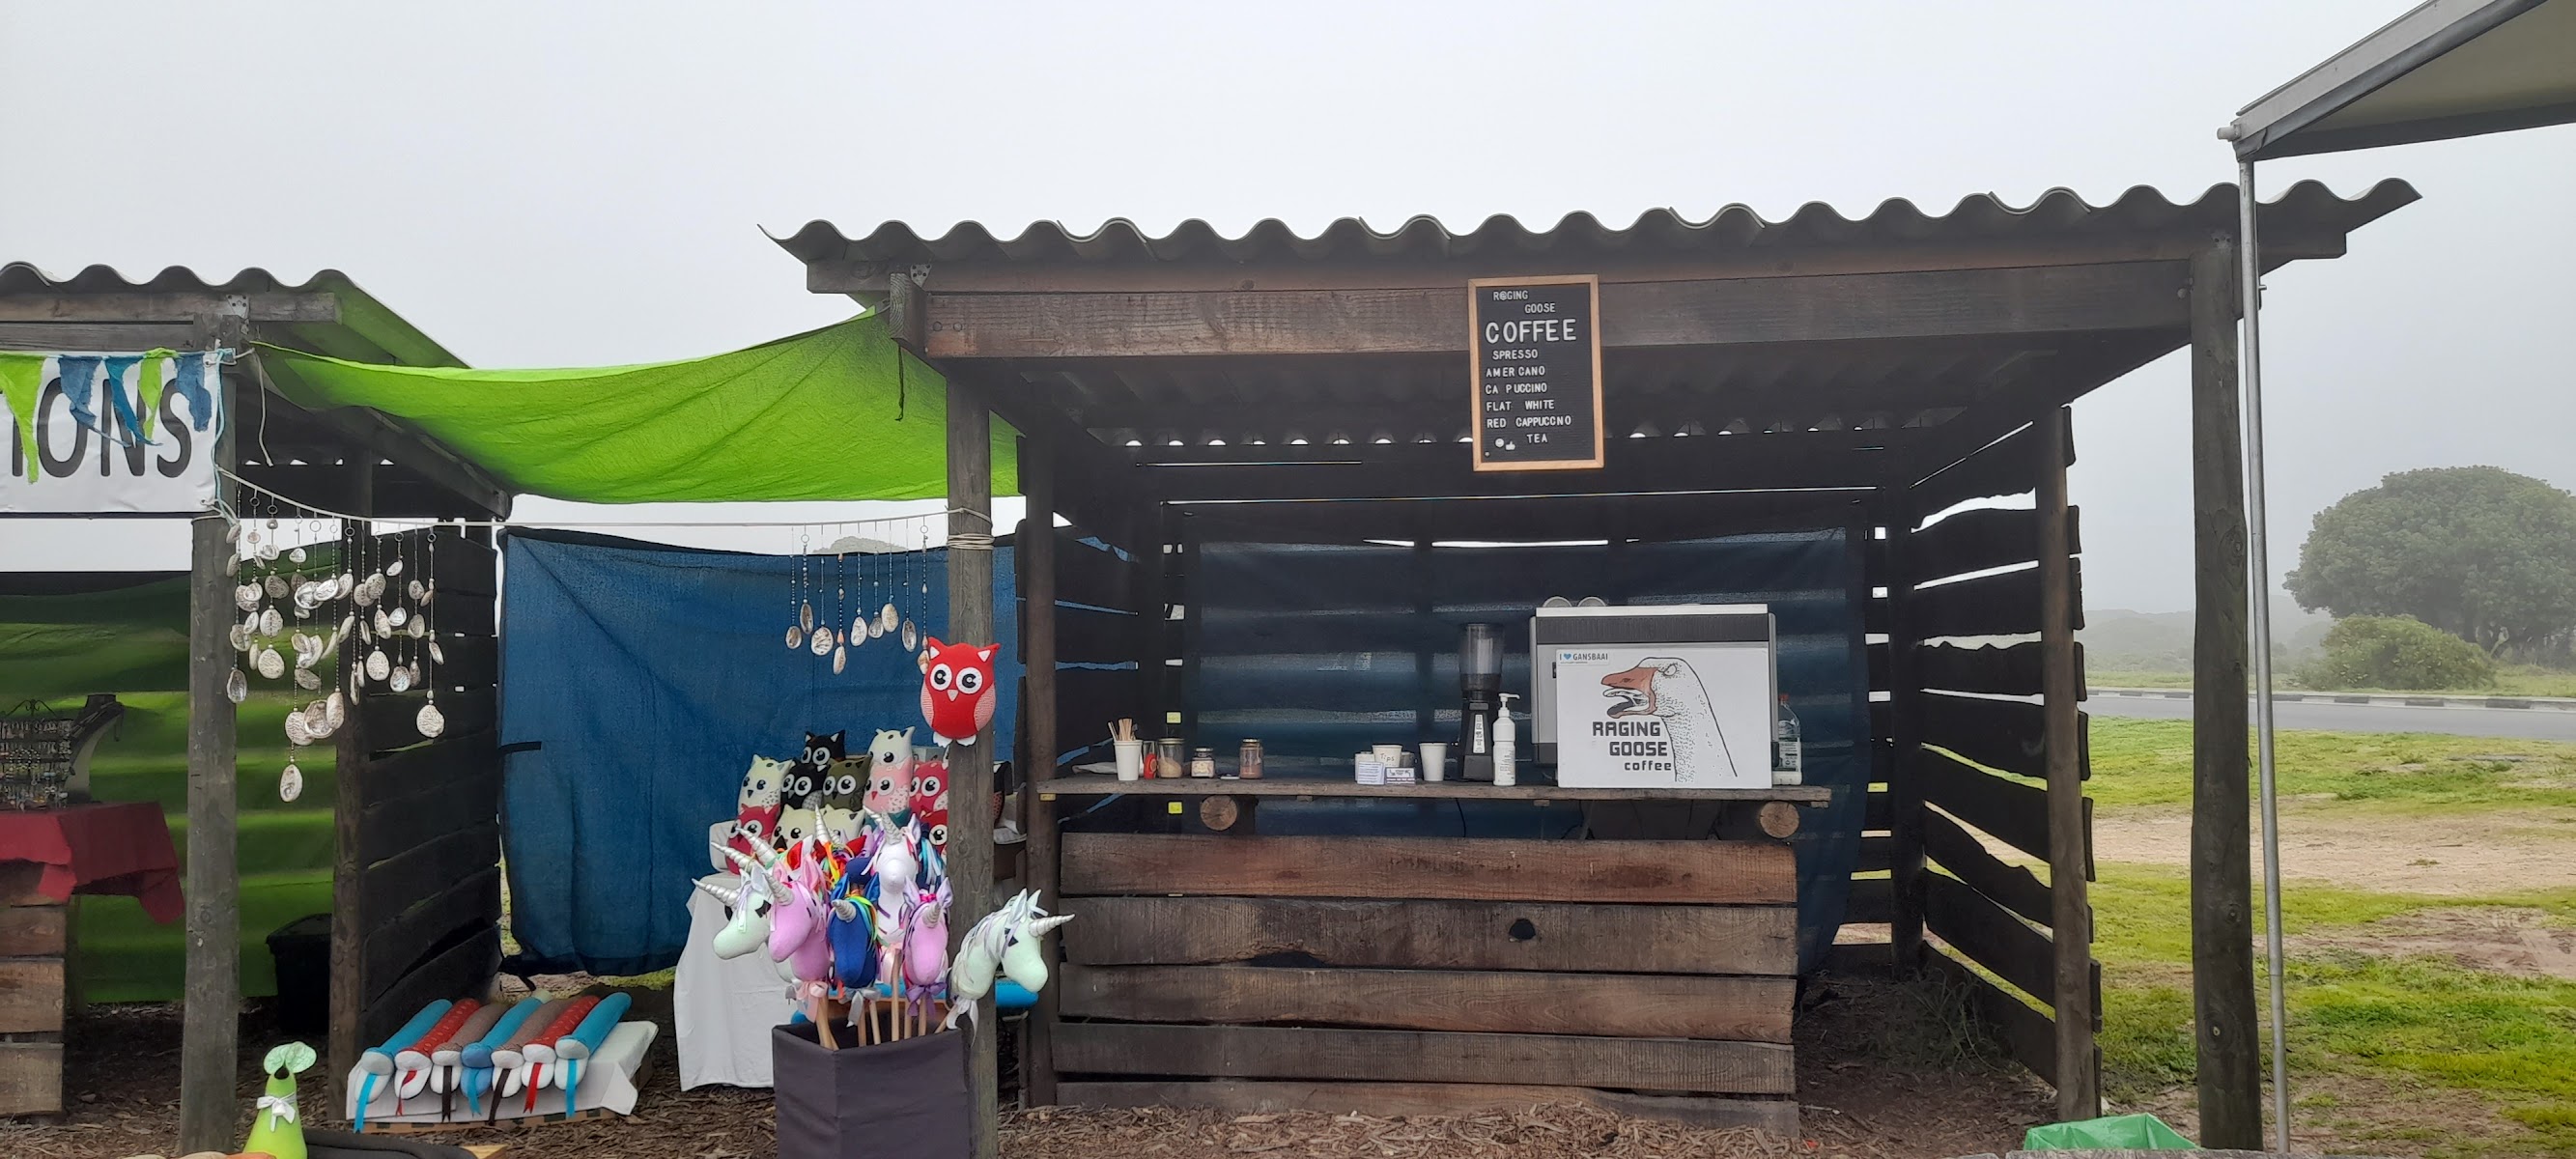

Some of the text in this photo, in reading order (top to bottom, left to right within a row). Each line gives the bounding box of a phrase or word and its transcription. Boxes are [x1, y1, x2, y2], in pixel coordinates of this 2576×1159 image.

[1524, 303, 1555, 313] GOOSE
[1486, 319, 1576, 343] COFFEE
[1492, 349, 1538, 360] SPRESSO
[1486, 400, 1555, 411] FLAT WHITE
[1486, 418, 1507, 428] RED
[1527, 434, 1547, 443] TEA
[1593, 721, 1660, 737] RAGING
[1610, 742, 1667, 756] GOOSE
[1625, 760, 1672, 771] coffee
